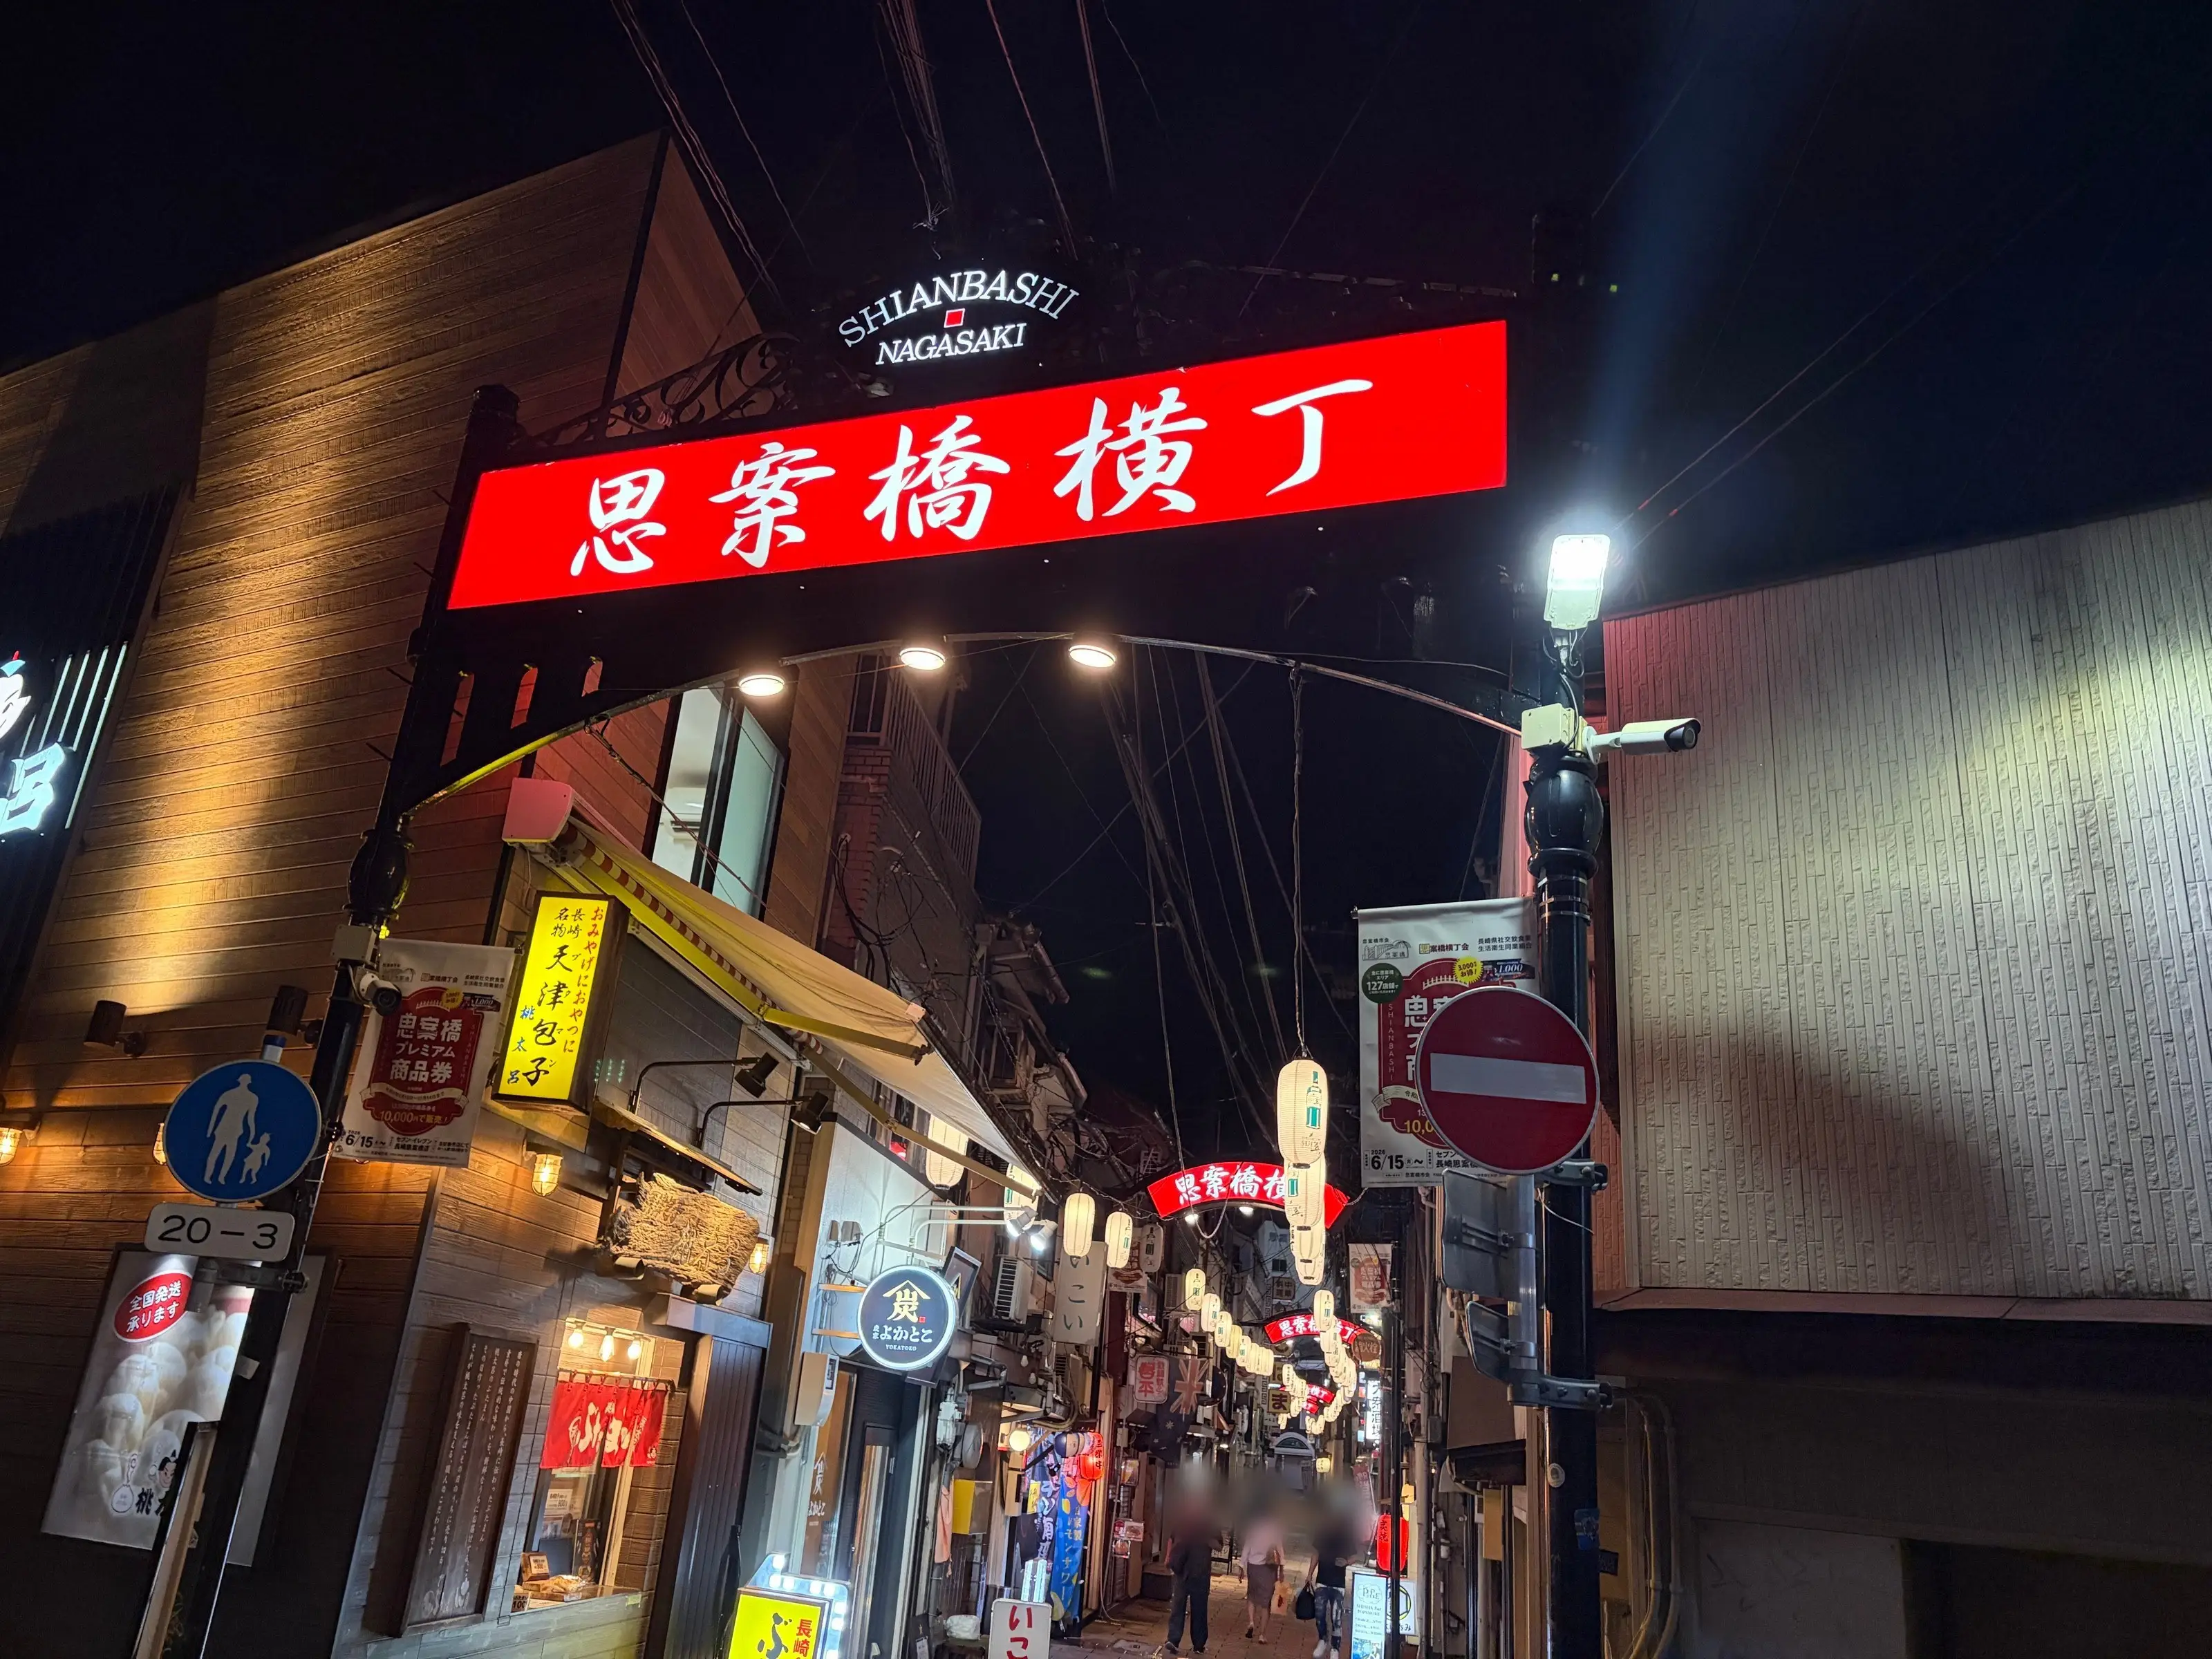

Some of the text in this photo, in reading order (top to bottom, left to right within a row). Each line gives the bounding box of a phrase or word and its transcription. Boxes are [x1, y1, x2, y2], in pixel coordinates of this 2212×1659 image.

[838, 270, 1079, 347] SHIANBASHI
[875, 323, 1027, 365] NAGASAKI
[570, 379, 1374, 578] 思案橋横丁
[551, 907, 568, 937] 名物
[567, 908, 585, 939] 長崎
[563, 906, 603, 1053] おみやげにおやつに
[396, 1012, 462, 1043] 思案橋
[522, 944, 572, 1086] 天津包子
[395, 1041, 456, 1058] プレミアム
[507, 1004, 536, 1085] 桃太呂
[389, 1058, 453, 1084] 商品券
[346, 1133, 373, 1148] 6/15
[1371, 1154, 1405, 1170] 6/15
[1174, 1164, 1288, 1203] 思案橋横
[158, 1214, 279, 1250] 20-3
[129, 1280, 182, 1313] 全国発送
[126, 1301, 180, 1333] 承ります
[879, 1324, 932, 1343] よかとこ
[792, 1619, 812, 1658] 長崎
